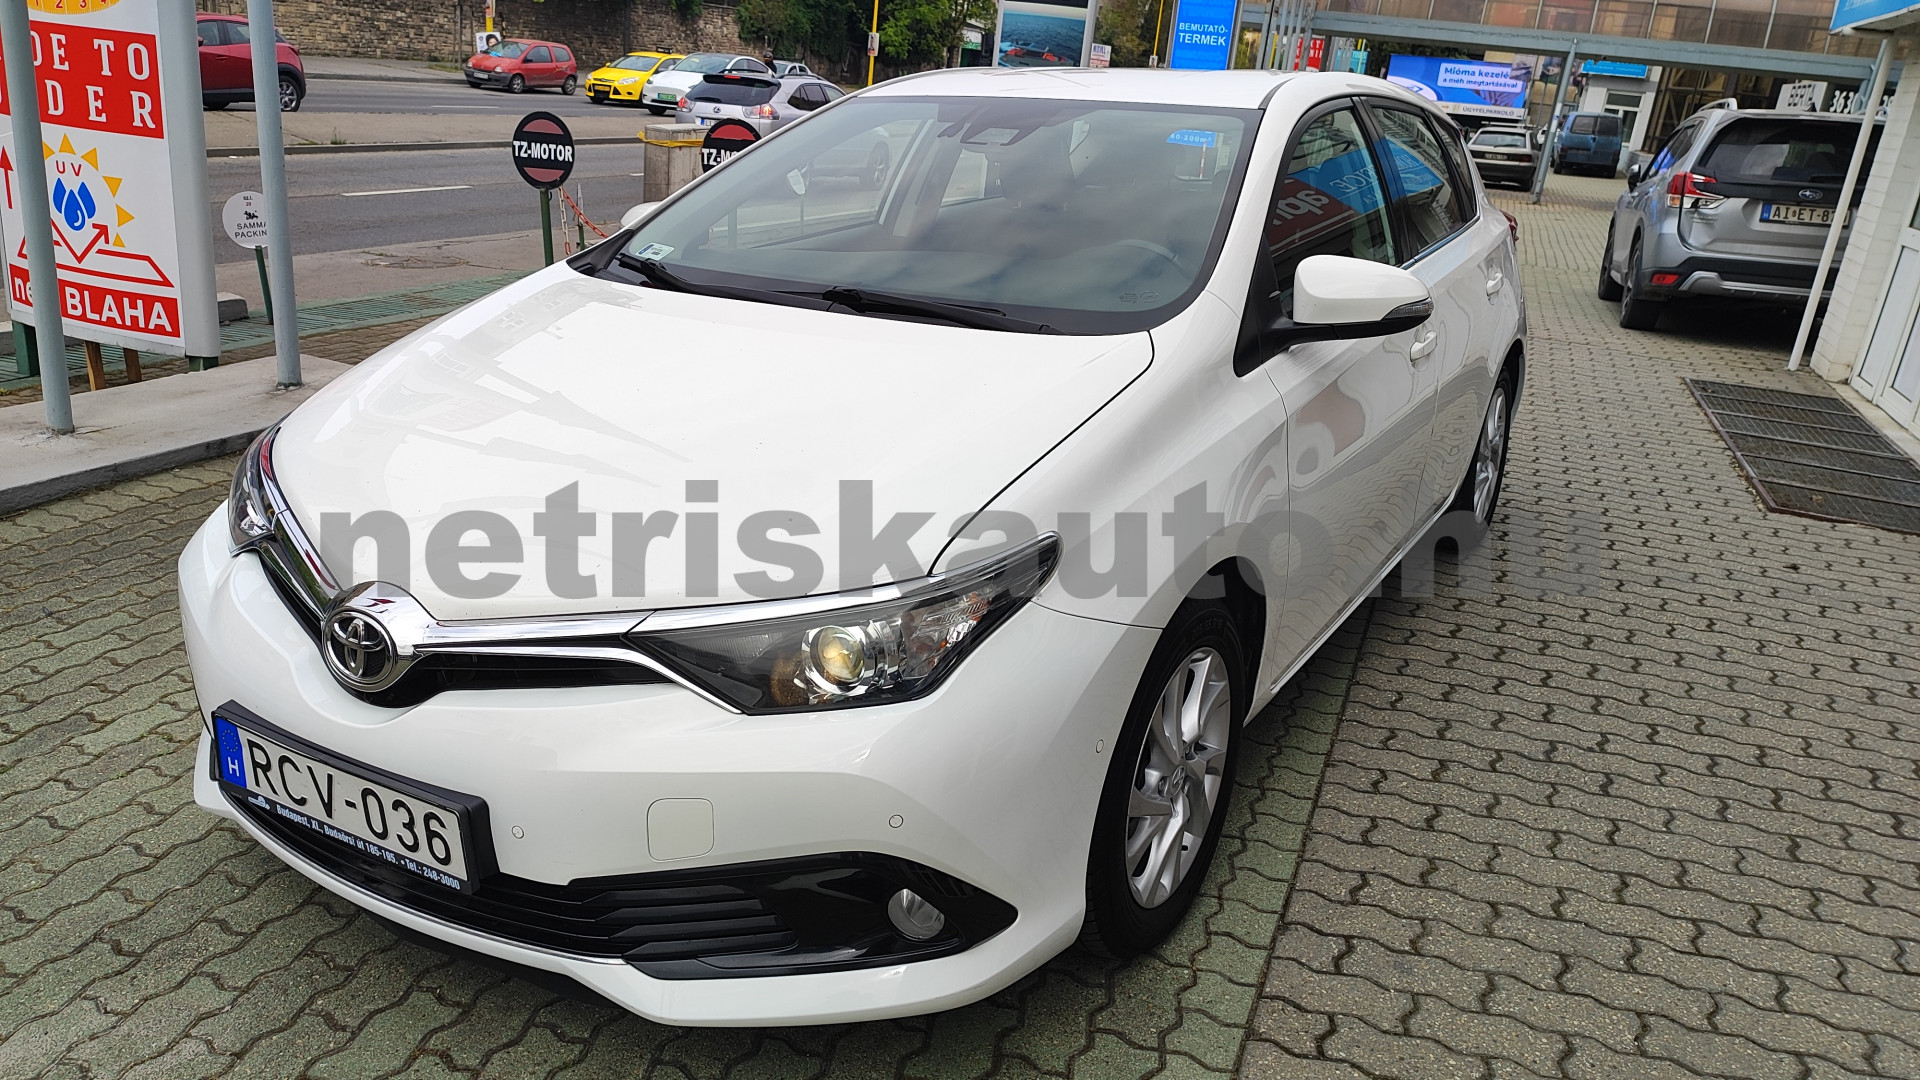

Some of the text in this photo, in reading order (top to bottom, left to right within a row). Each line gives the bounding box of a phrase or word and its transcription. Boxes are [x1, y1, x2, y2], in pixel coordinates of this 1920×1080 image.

[1179, 22, 1228, 33] BEMUTATÓ-
[1178, 33, 1227, 46] TERMEK
[30, 30, 150, 81] DE TO
[1444, 66, 1476, 77] Mióma
[44, 79, 156, 129] DER
[512, 140, 573, 162] TZ-MOTOR
[701, 147, 741, 166] TZ-M
[56, 160, 82, 177] UV
[234, 230, 267, 238] PACKIN
[64, 286, 173, 332] BLAHA
[227, 738, 452, 867] H RCV-036
[276, 804, 311, 828] Budapest,
[423, 866, 461, 891] 248-3000
